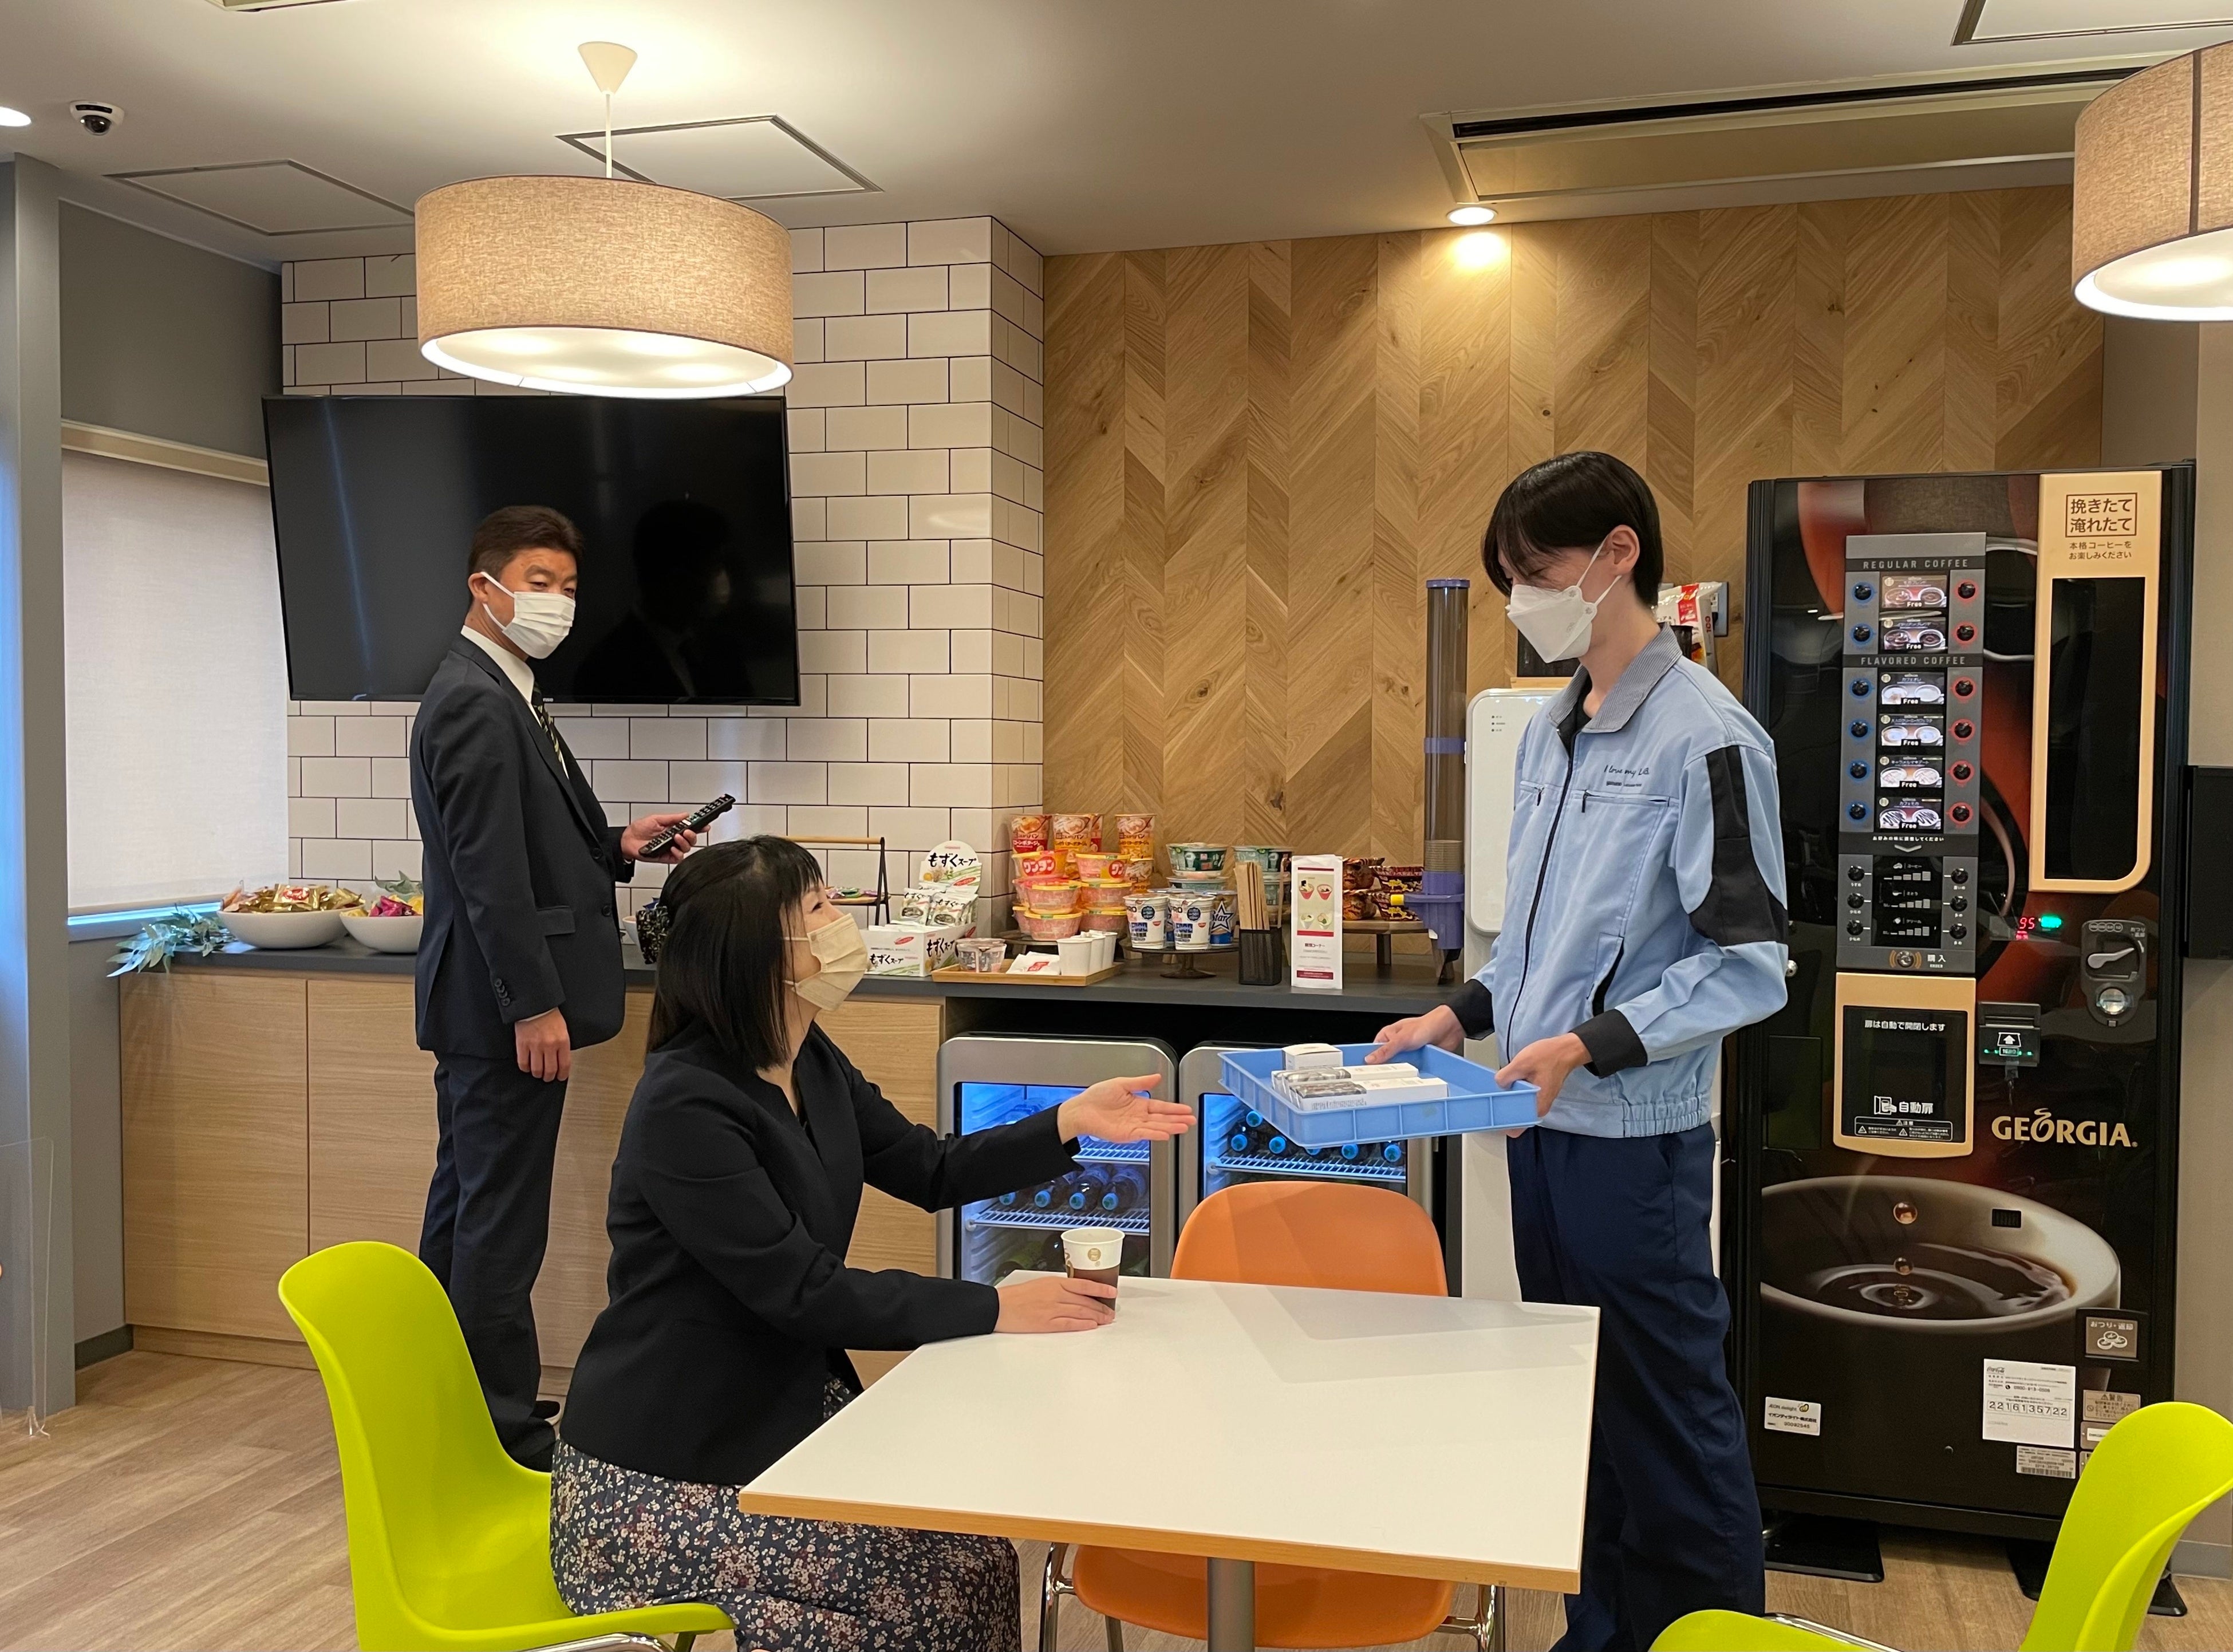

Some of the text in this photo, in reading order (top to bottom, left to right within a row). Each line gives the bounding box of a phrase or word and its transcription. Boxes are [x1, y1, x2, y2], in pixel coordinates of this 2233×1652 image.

[2071, 498, 2132, 514] 挽きたて
[2070, 518, 2132, 533] 淹れたて
[2069, 541, 2132, 550] 本格コーヒーを
[2069, 551, 2132, 560] お楽しみください
[1863, 559, 1968, 569] REGULAR COFFEE
[1861, 657, 1916, 665] FLAVORED
[928, 853, 977, 868] もずくスープ
[1023, 859, 1055, 873] ワンタン
[2019, 917, 2035, 929] 95
[869, 953, 904, 965] もずくスープ
[1864, 1019, 1946, 1031] 扉は自動で開閉します
[1899, 1101, 1934, 1114] 自動扉
[1991, 1107, 2132, 1148] GEORGIA
